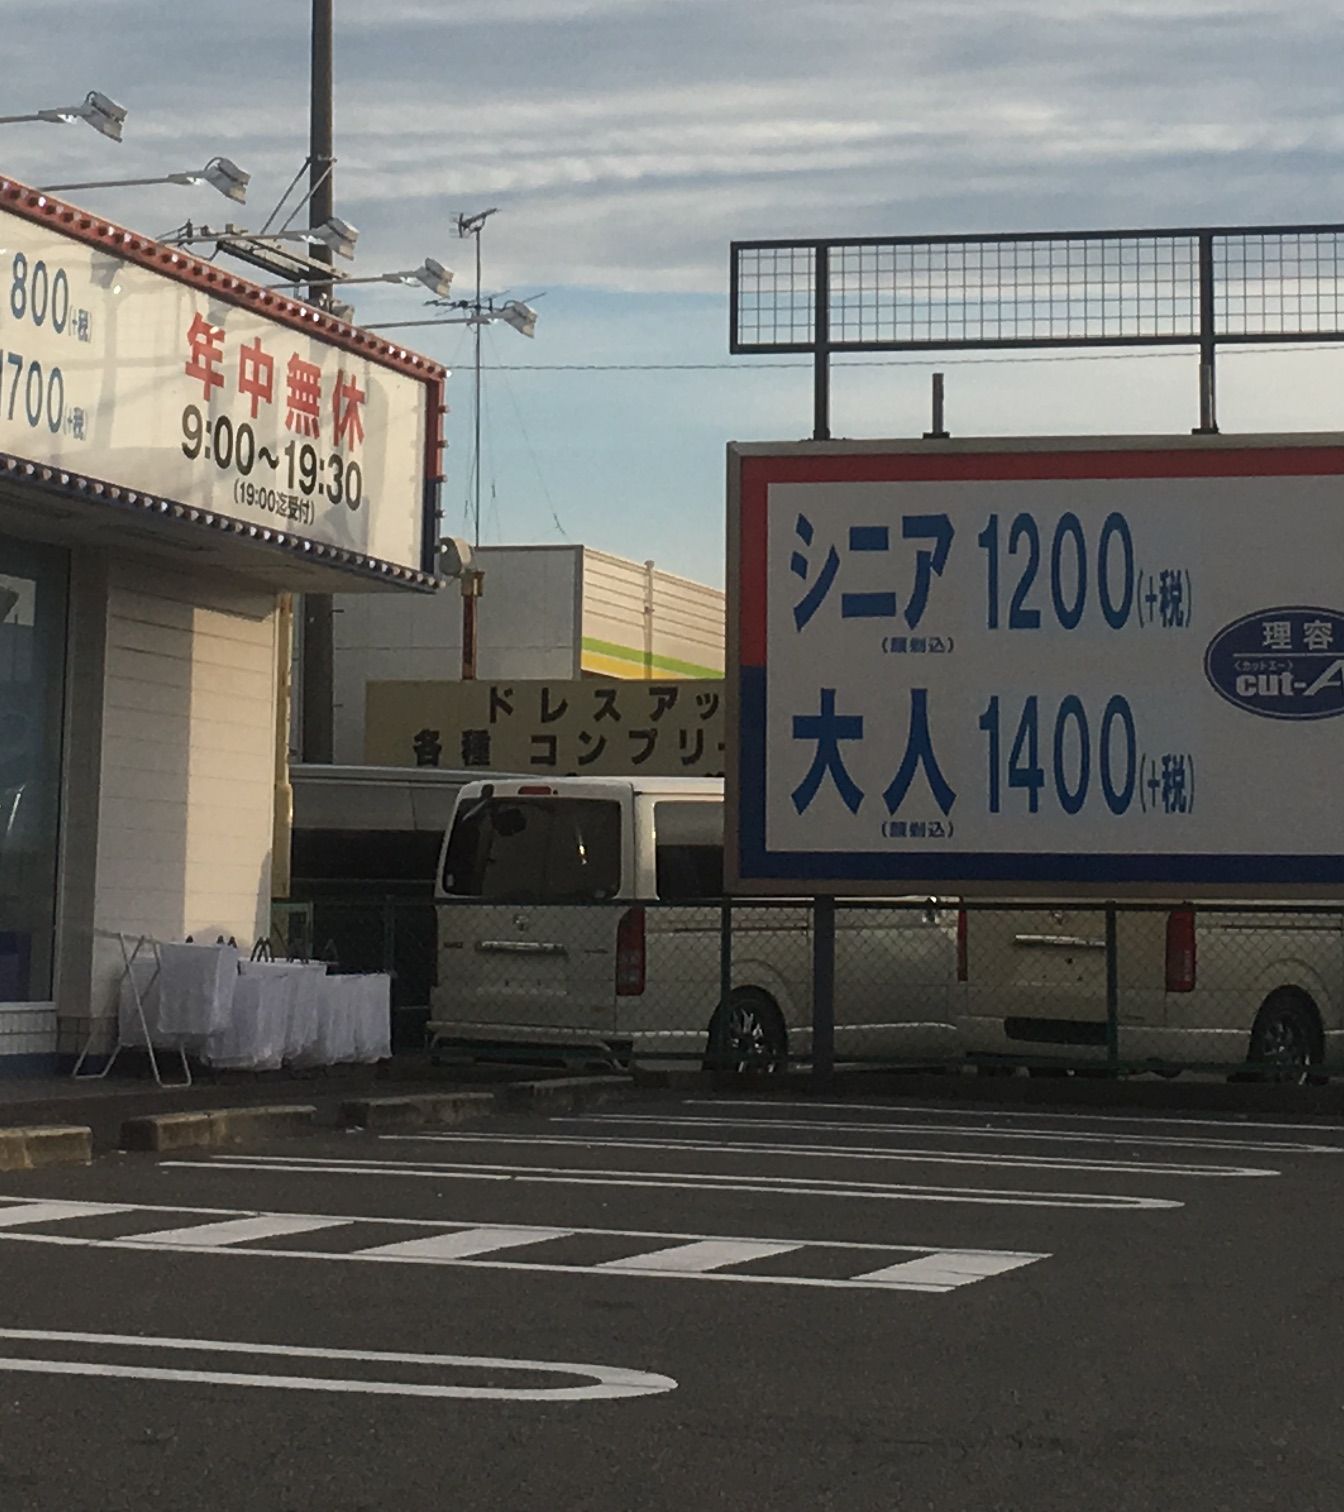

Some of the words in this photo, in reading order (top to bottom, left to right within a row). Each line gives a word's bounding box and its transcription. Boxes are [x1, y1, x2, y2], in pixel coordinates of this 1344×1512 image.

[10, 252, 68, 334] 800
[185, 311, 366, 453] 年中無休
[790, 513, 956, 632] シニア
[978, 512, 1134, 630] 1200
[1262, 619, 1334, 651] 理容
[790, 687, 957, 817] 大人
[978, 694, 1137, 815] 1400
